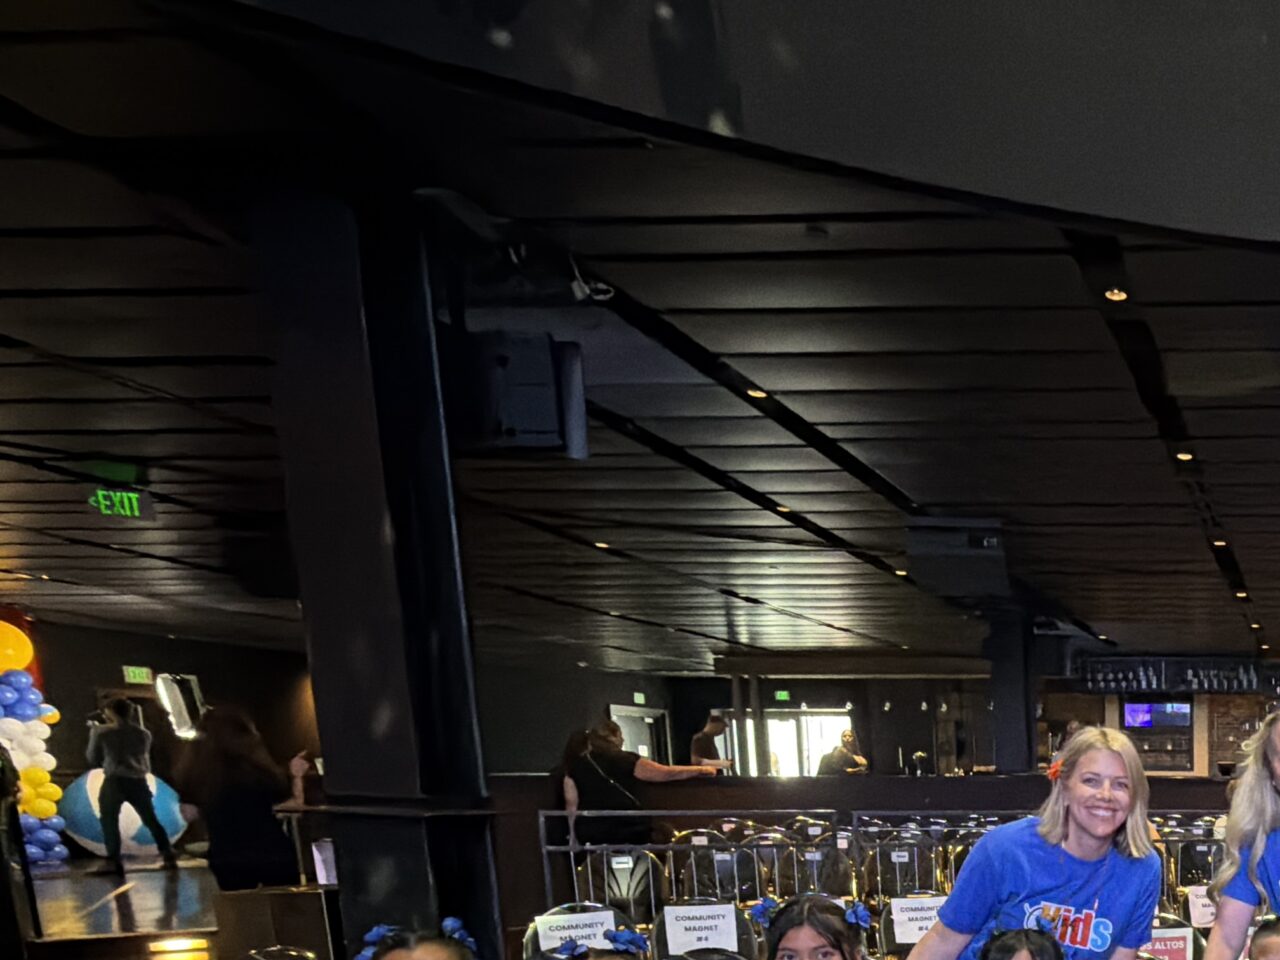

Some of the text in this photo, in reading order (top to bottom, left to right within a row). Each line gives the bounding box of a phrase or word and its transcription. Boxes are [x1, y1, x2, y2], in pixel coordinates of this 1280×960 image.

[97, 489, 140, 516] EXIT
[675, 913, 726, 922] COMMUNITY
[548, 921, 604, 932] COMMUNITY
[684, 924, 718, 932] MAGNET
[1154, 941, 1185, 950] ALTOS
